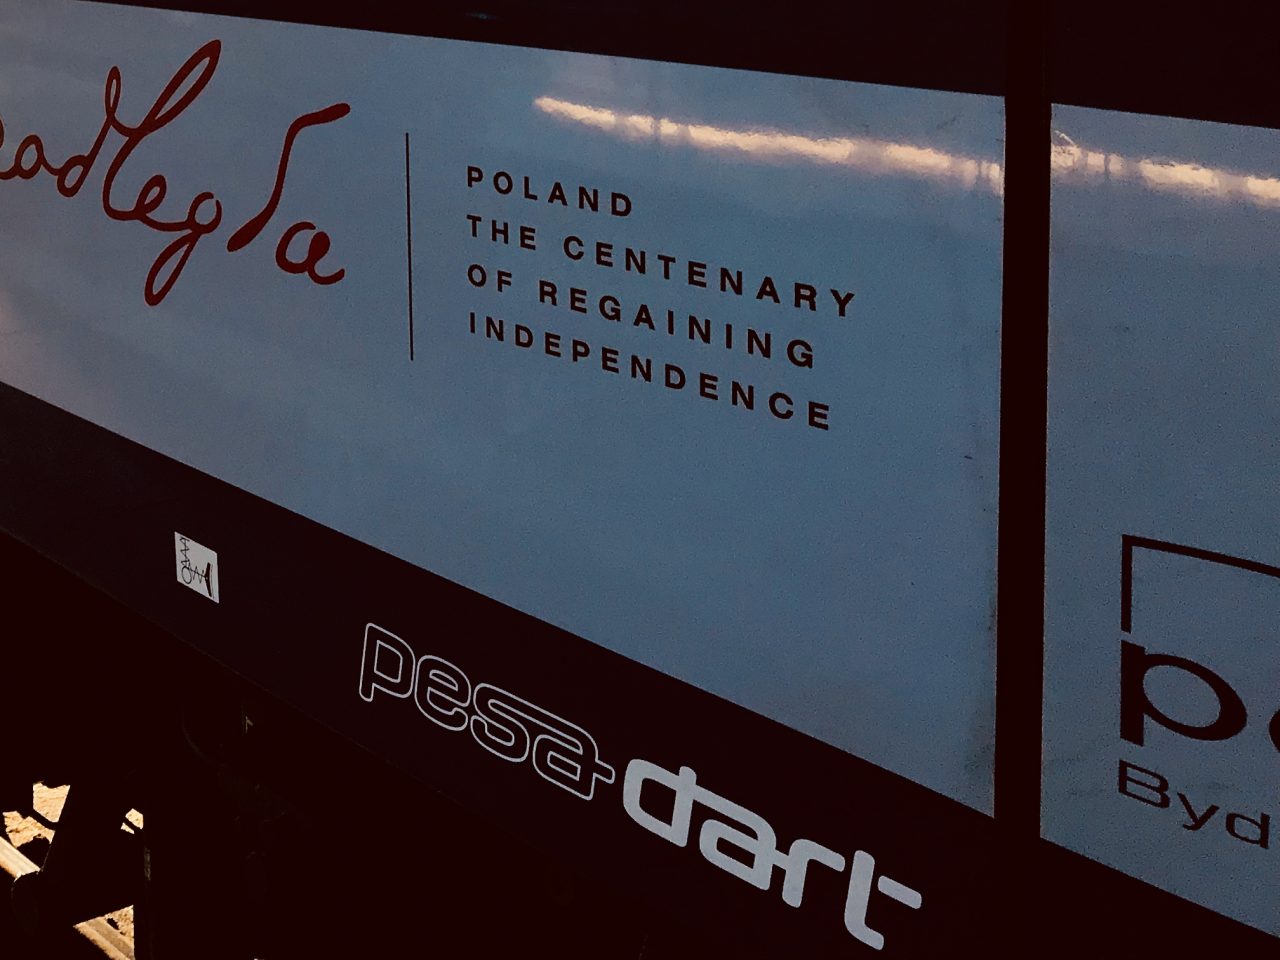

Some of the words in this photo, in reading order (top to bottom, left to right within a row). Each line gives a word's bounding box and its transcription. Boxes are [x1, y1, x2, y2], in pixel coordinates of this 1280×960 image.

[466, 165, 633, 217] POLAND
[466, 214, 537, 251] THE
[563, 236, 856, 318] CENTENARY
[467, 263, 513, 293] OF
[538, 280, 815, 369] REGAINING
[469, 312, 831, 431] INDEPENDENCE
[1120, 639, 1280, 755] p
[359, 622, 616, 801] pesa
[622, 758, 923, 951] dart
